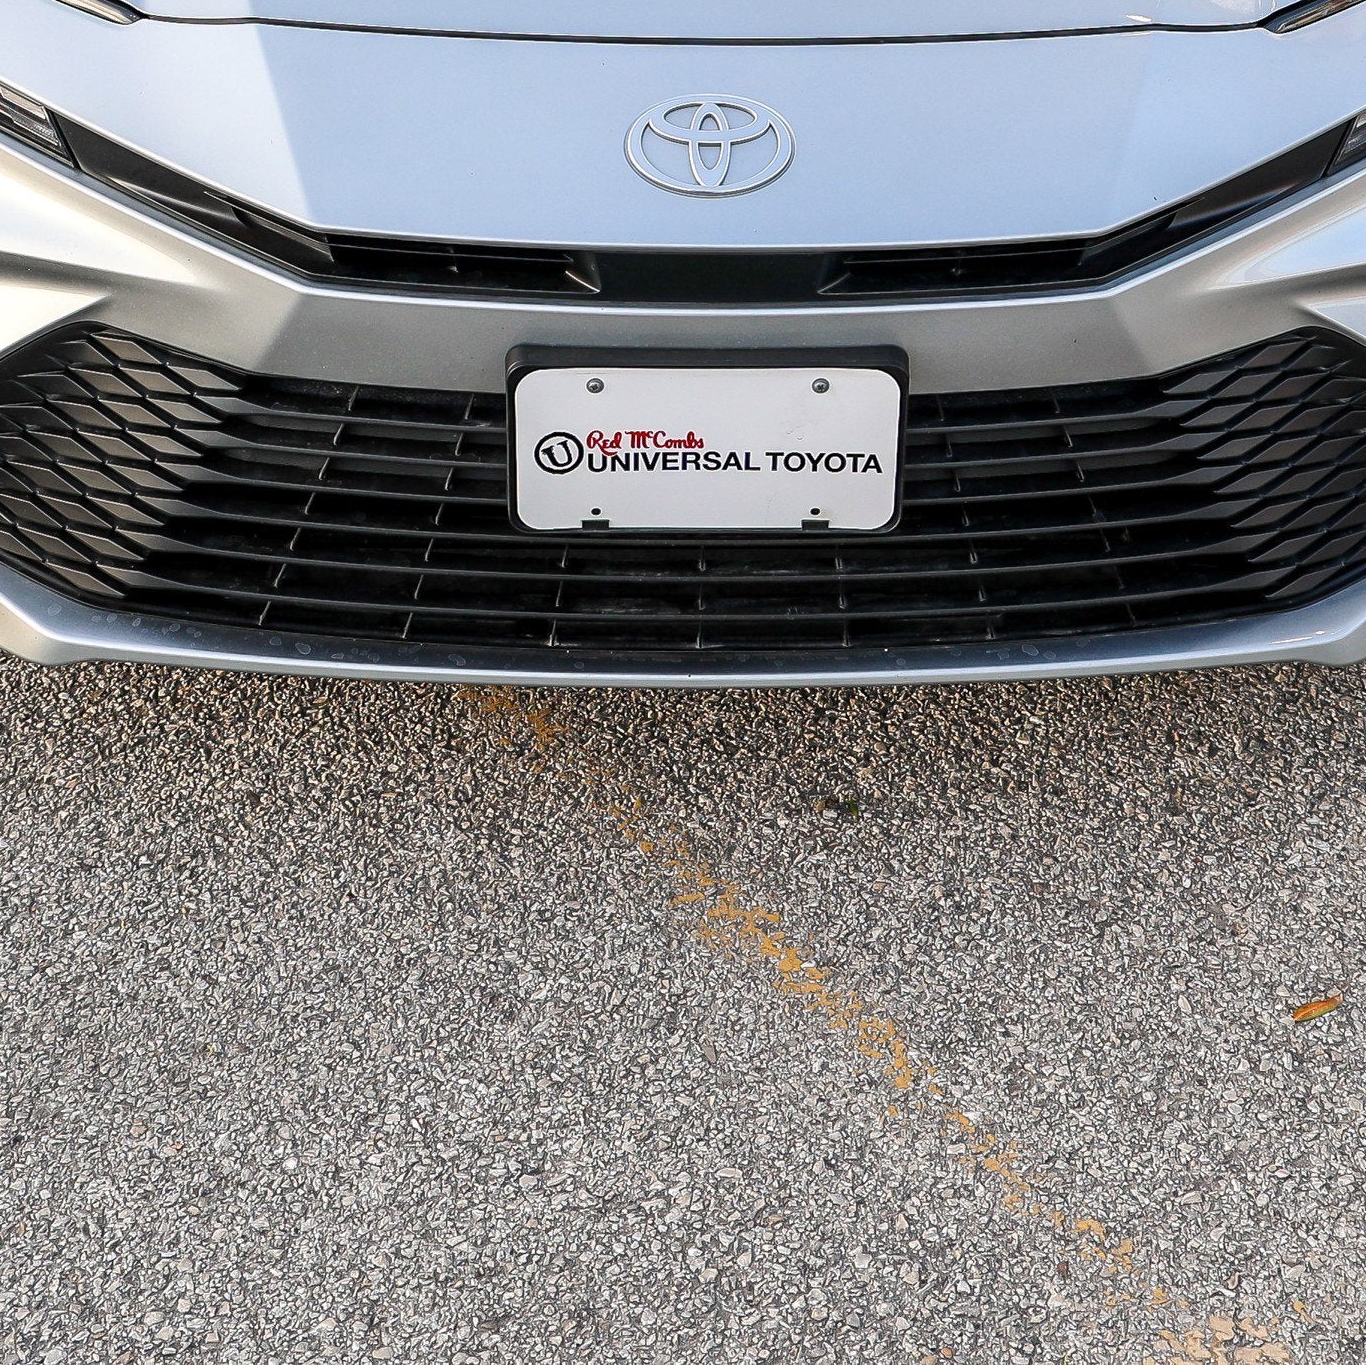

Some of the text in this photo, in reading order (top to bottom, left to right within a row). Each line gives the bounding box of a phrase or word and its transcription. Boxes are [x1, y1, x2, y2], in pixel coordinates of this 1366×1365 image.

[586, 430, 705, 456] Red McCombs
[587, 451, 883, 474] UNIVERSAL TOYOTA
